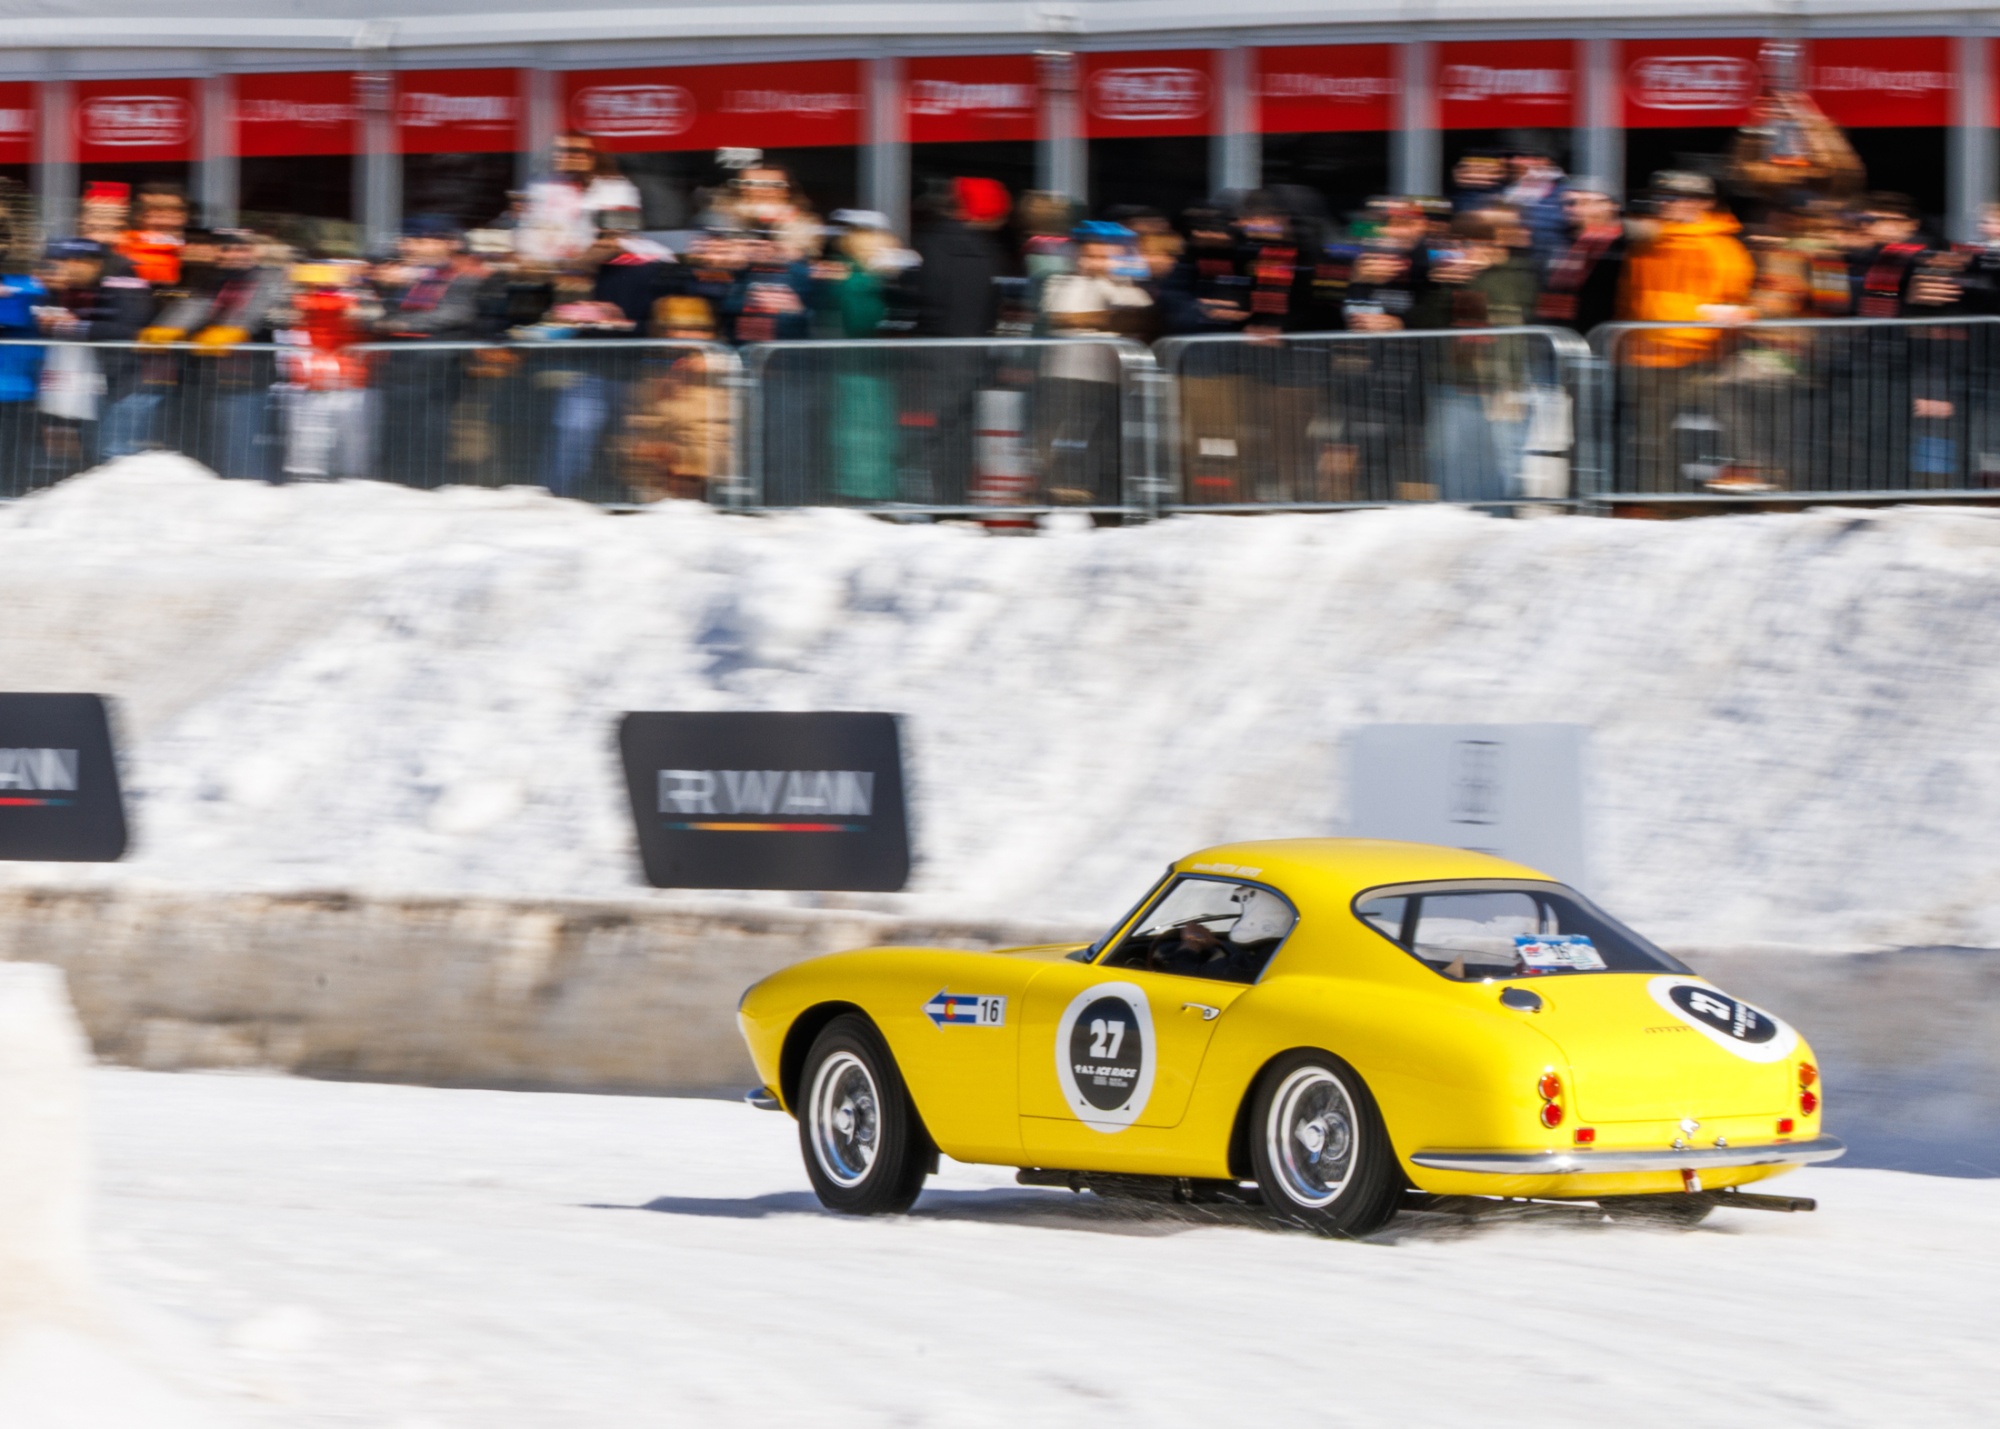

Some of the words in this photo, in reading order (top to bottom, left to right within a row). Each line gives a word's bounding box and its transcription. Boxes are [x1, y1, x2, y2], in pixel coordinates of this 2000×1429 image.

[981, 999, 999, 1022] 16
[1089, 1018, 1126, 1059] 27
[1095, 1066, 1112, 1076] ICE
[1111, 1067, 1138, 1078] RACE
